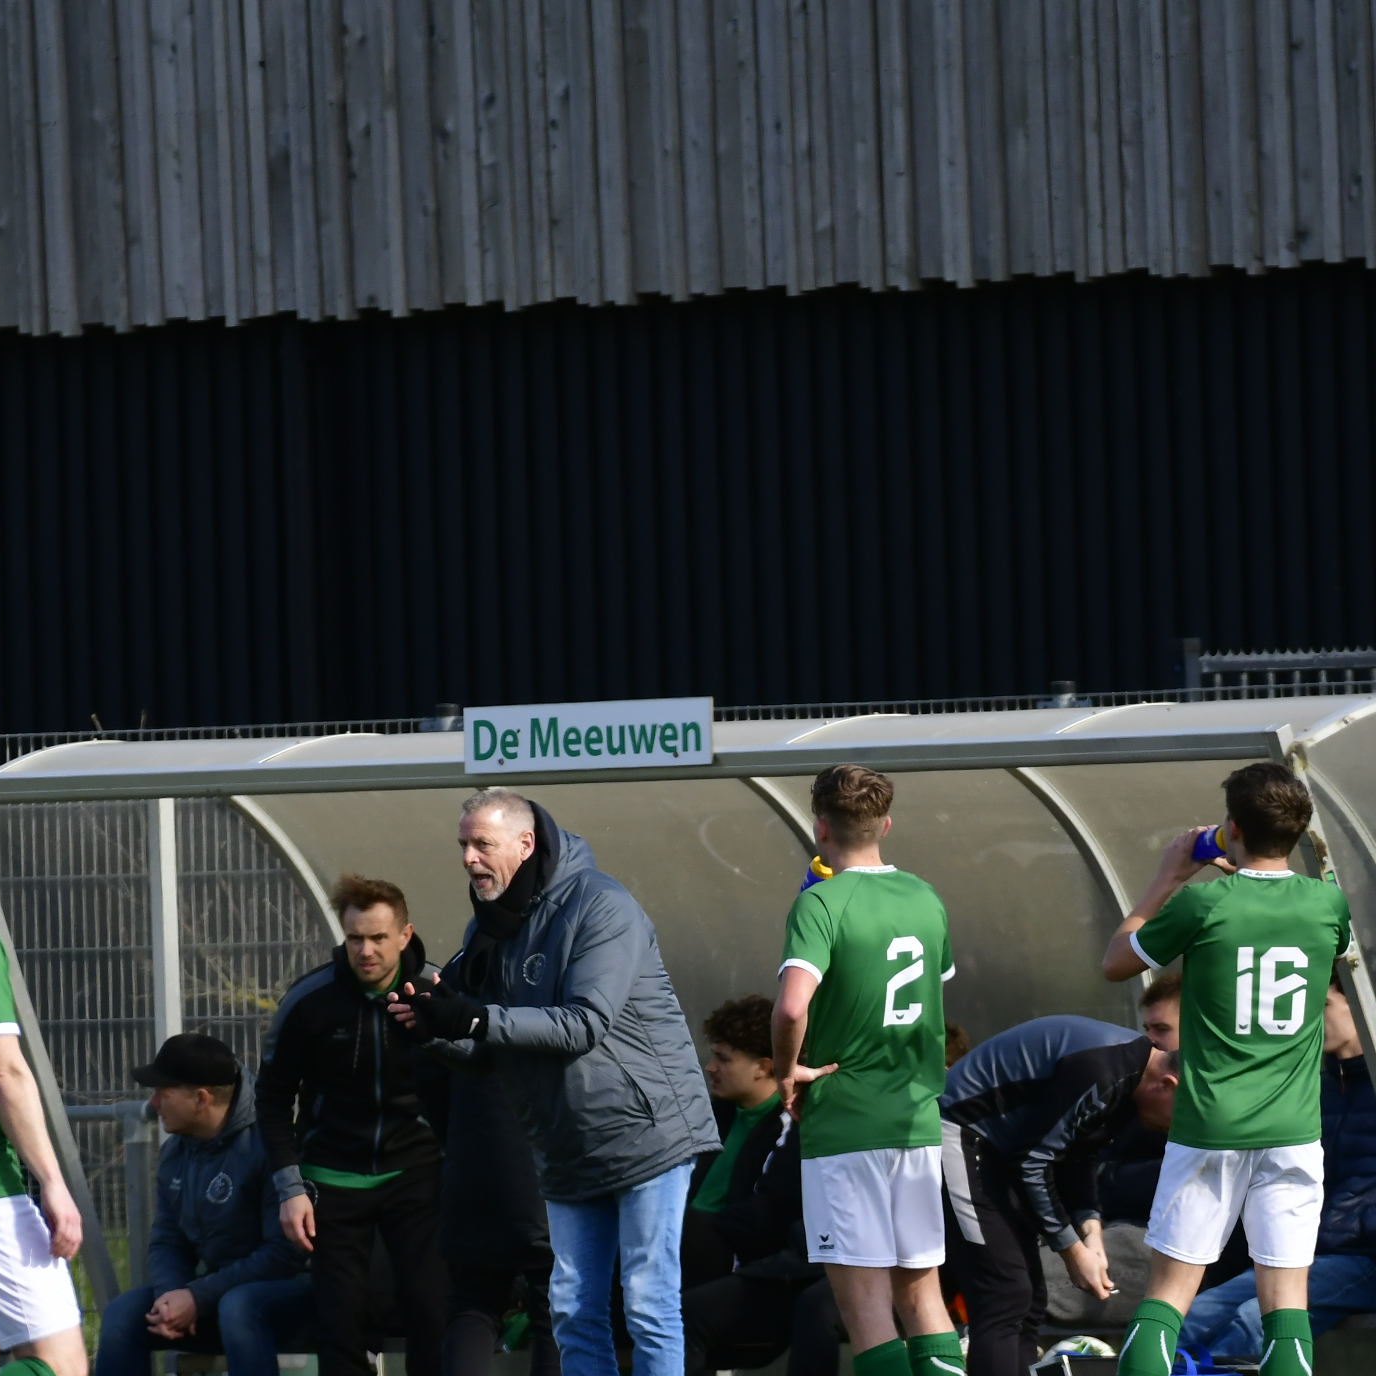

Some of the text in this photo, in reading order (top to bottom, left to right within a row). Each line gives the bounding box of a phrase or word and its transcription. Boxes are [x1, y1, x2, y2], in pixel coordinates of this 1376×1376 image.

[473, 716, 703, 761] De Meeuwen
[883, 935, 924, 1027] 2
[1235, 946, 1309, 1035] 16
